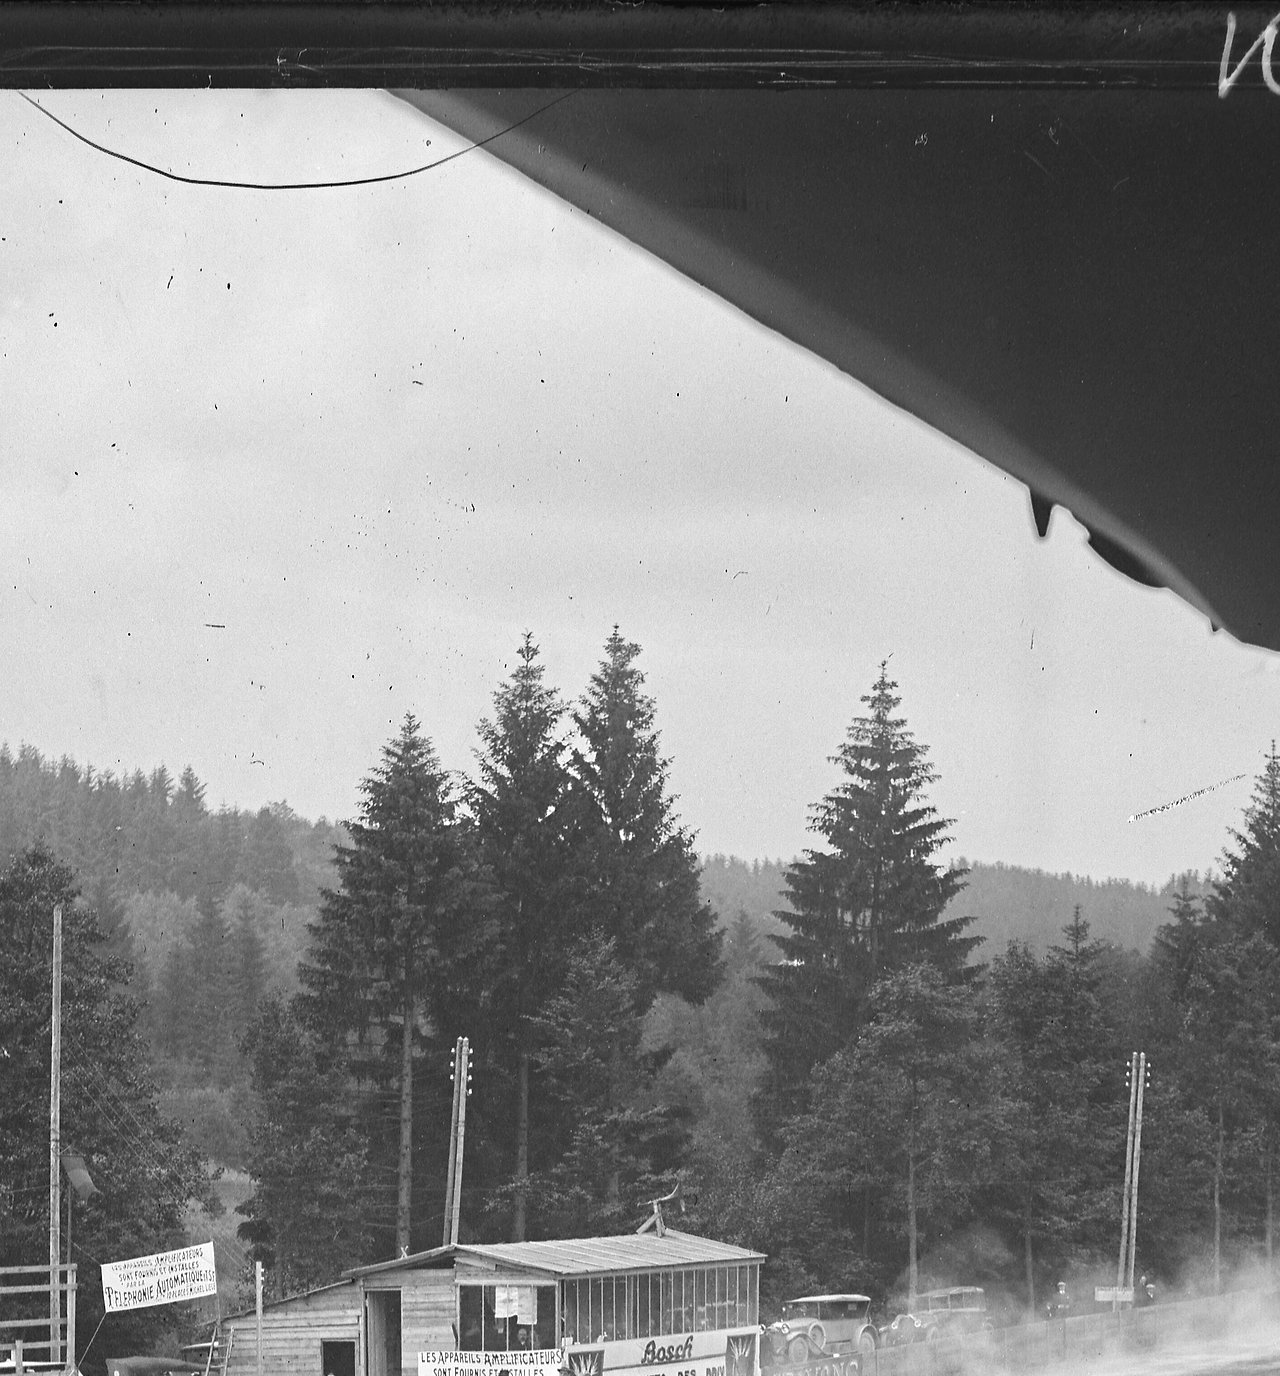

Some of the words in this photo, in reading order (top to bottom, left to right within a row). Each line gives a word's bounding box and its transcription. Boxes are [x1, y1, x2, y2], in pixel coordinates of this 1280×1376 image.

[104, 1285, 154, 1310] TELEPHONIE
[156, 1270, 203, 1299] AUTOMATIQUE
[421, 1352, 436, 1363] LES
[437, 1351, 481, 1364] APPAREILS
[484, 1350, 563, 1367] AMPLIFICATEURS
[641, 1335, 694, 1363] Bosch
